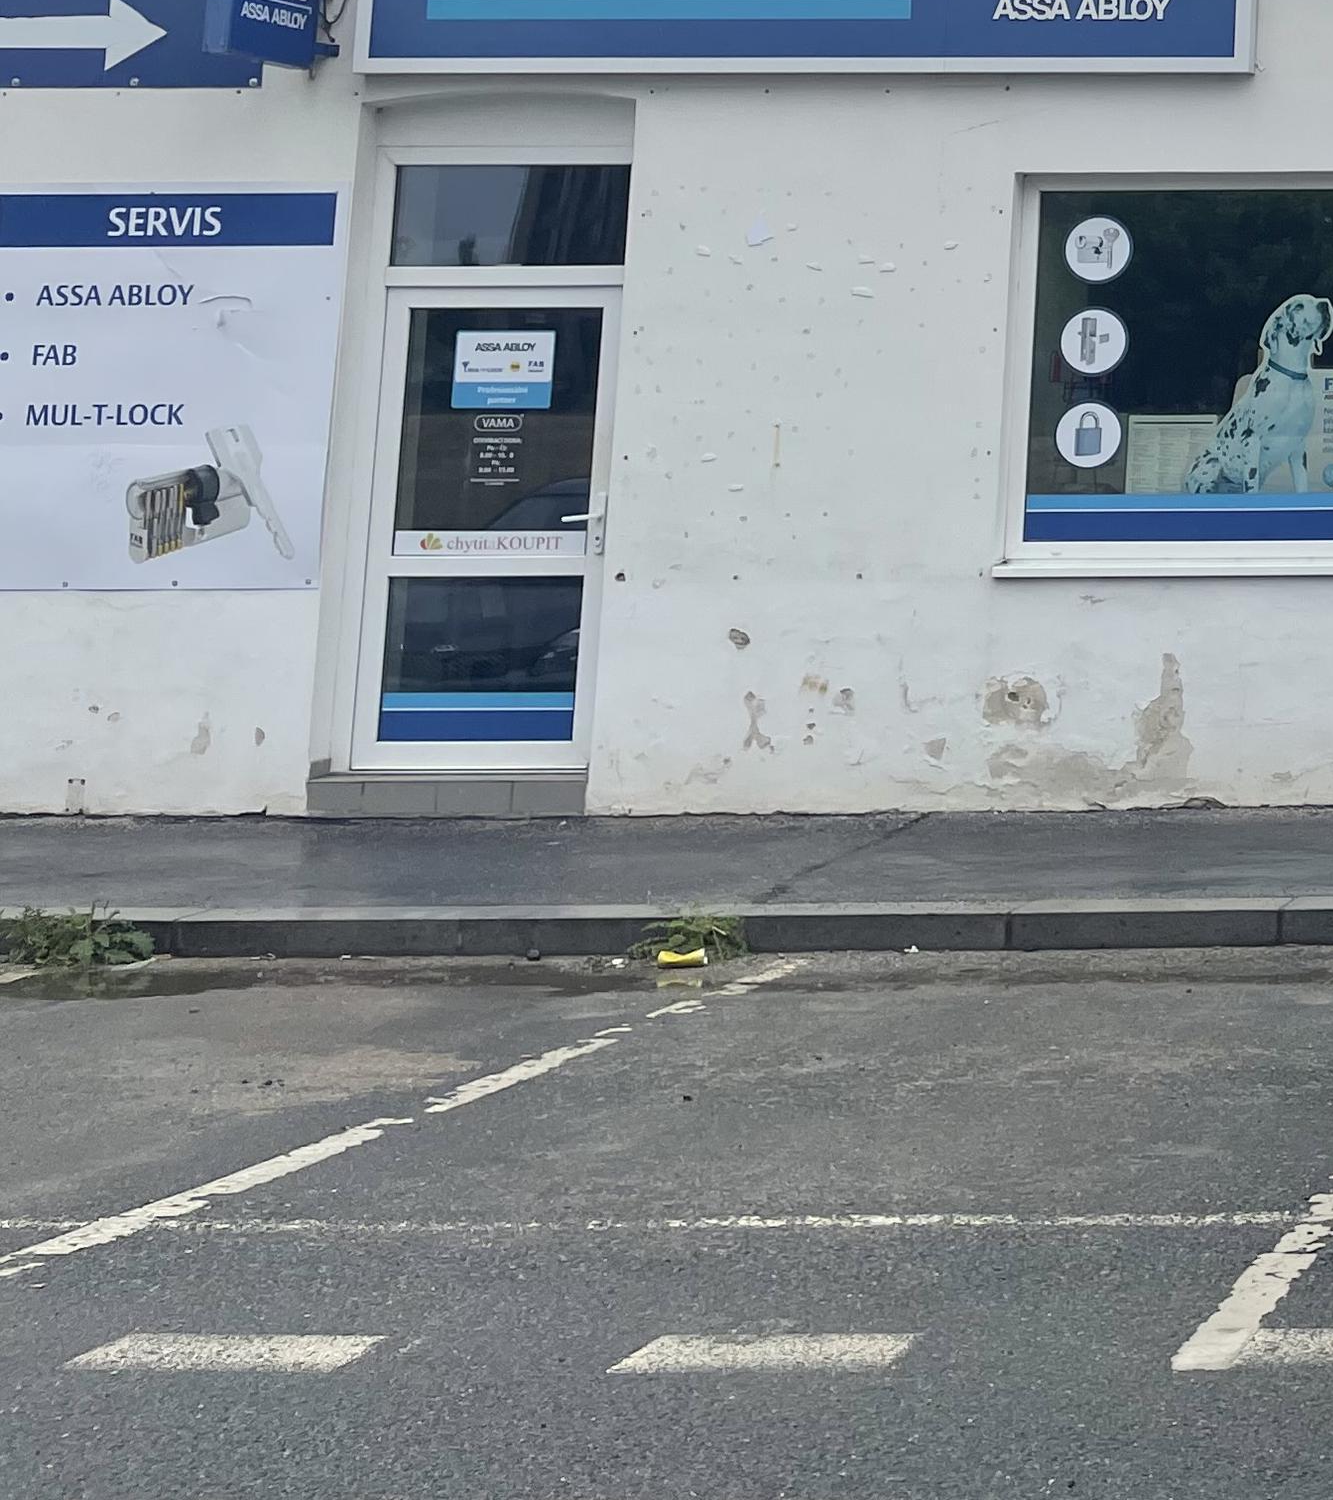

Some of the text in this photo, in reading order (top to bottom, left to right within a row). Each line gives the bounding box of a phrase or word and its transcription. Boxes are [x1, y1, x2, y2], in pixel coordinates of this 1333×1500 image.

[240, 1, 308, 30] ASSA ABLOY
[106, 206, 222, 237] SERVIS
[35, 284, 195, 307] ASSA ABLOY
[32, 344, 78, 367] FAB
[26, 403, 185, 427] MUL-T-LOCK
[481, 417, 515, 428] VAMA
